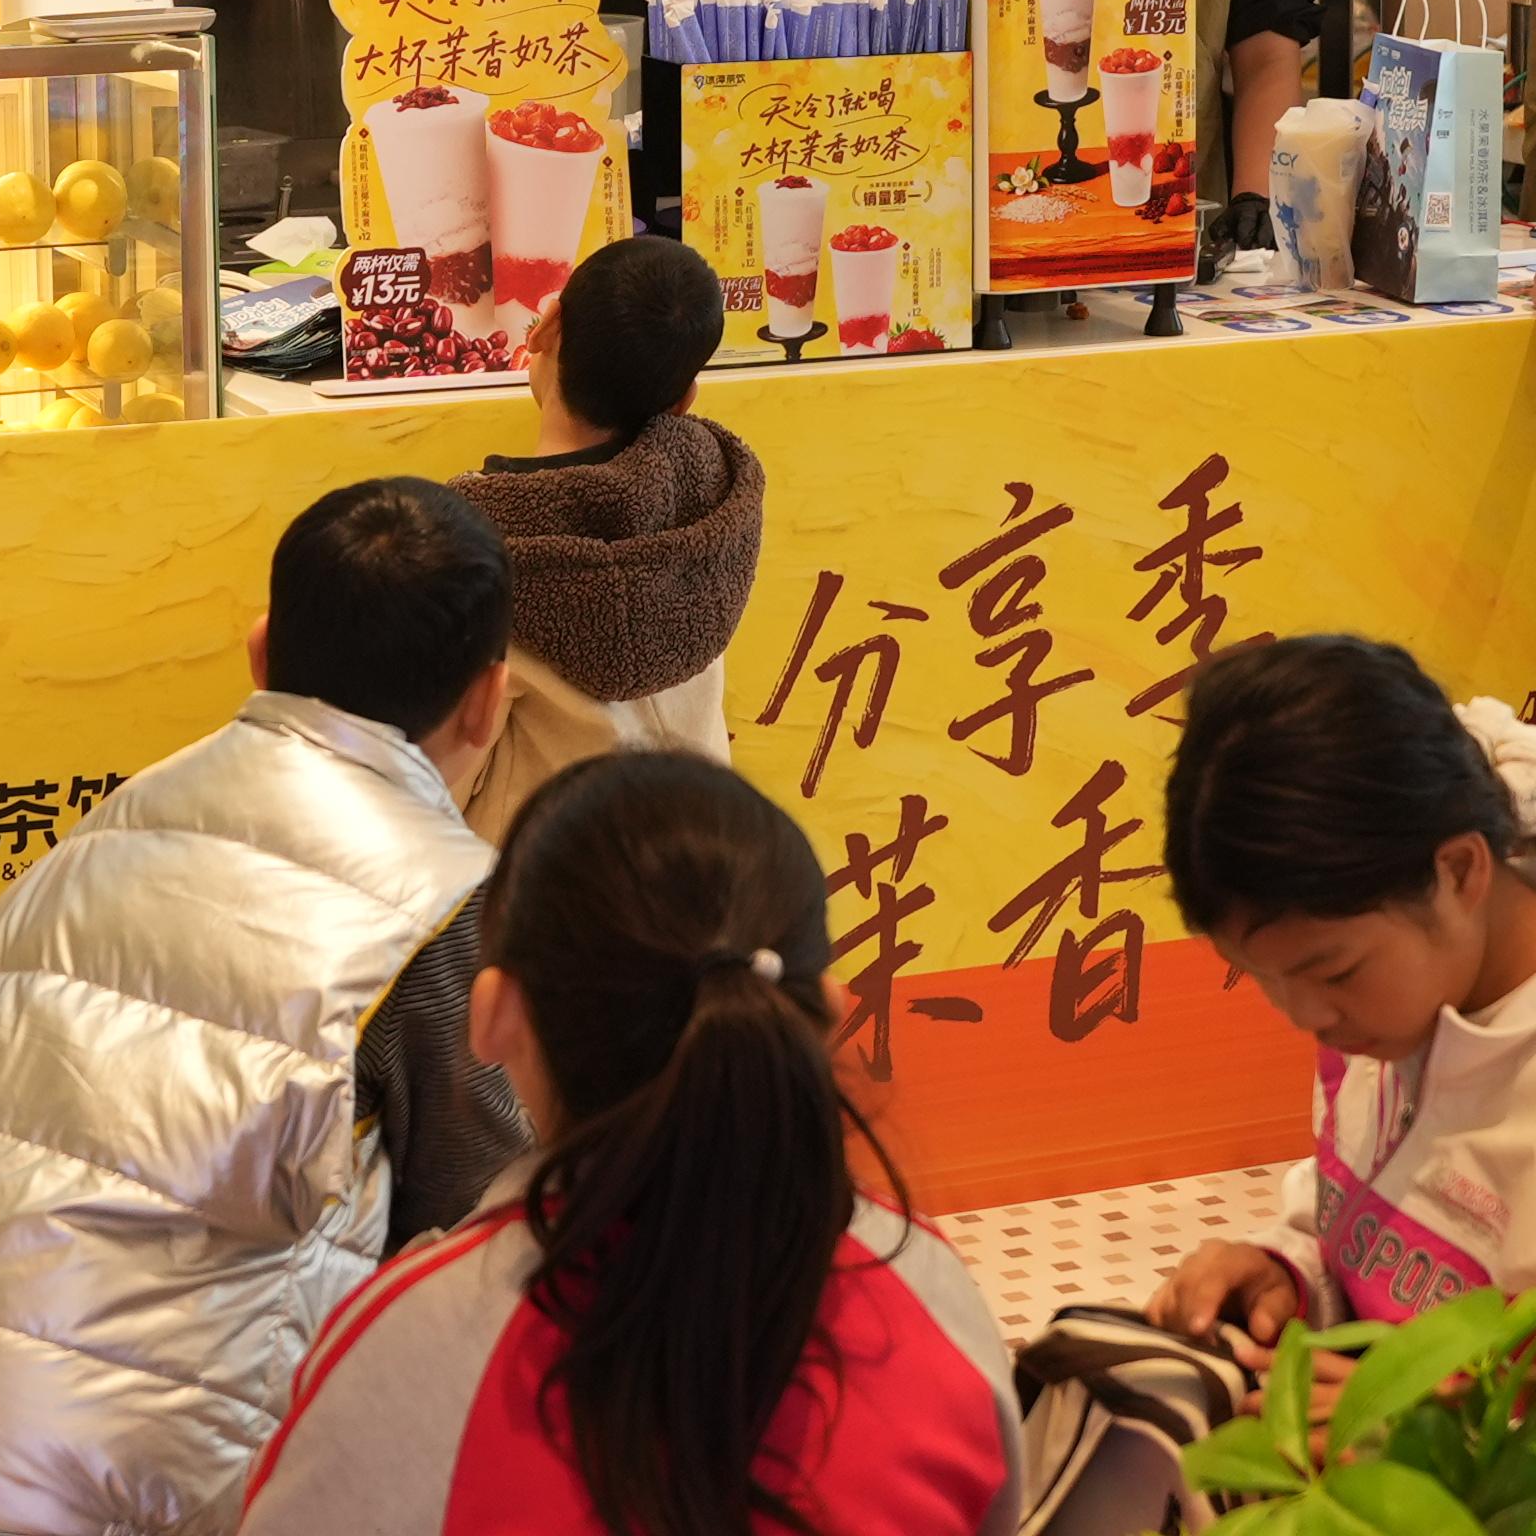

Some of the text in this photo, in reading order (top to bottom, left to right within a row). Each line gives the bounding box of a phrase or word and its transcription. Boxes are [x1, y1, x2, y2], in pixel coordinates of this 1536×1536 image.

[1126, 10, 1186, 35] ¥13元
[354, 22, 610, 88] 大杯茉香奶茶
[759, 78, 894, 129] 天冷了就喝
[740, 126, 921, 175] 大杯茉香奶茶
[864, 190, 922, 207] 销量第一
[353, 252, 421, 275] 两杯仅需
[352, 272, 421, 307] ¥13元
[1339, 1214, 1464, 1314] SPOR
